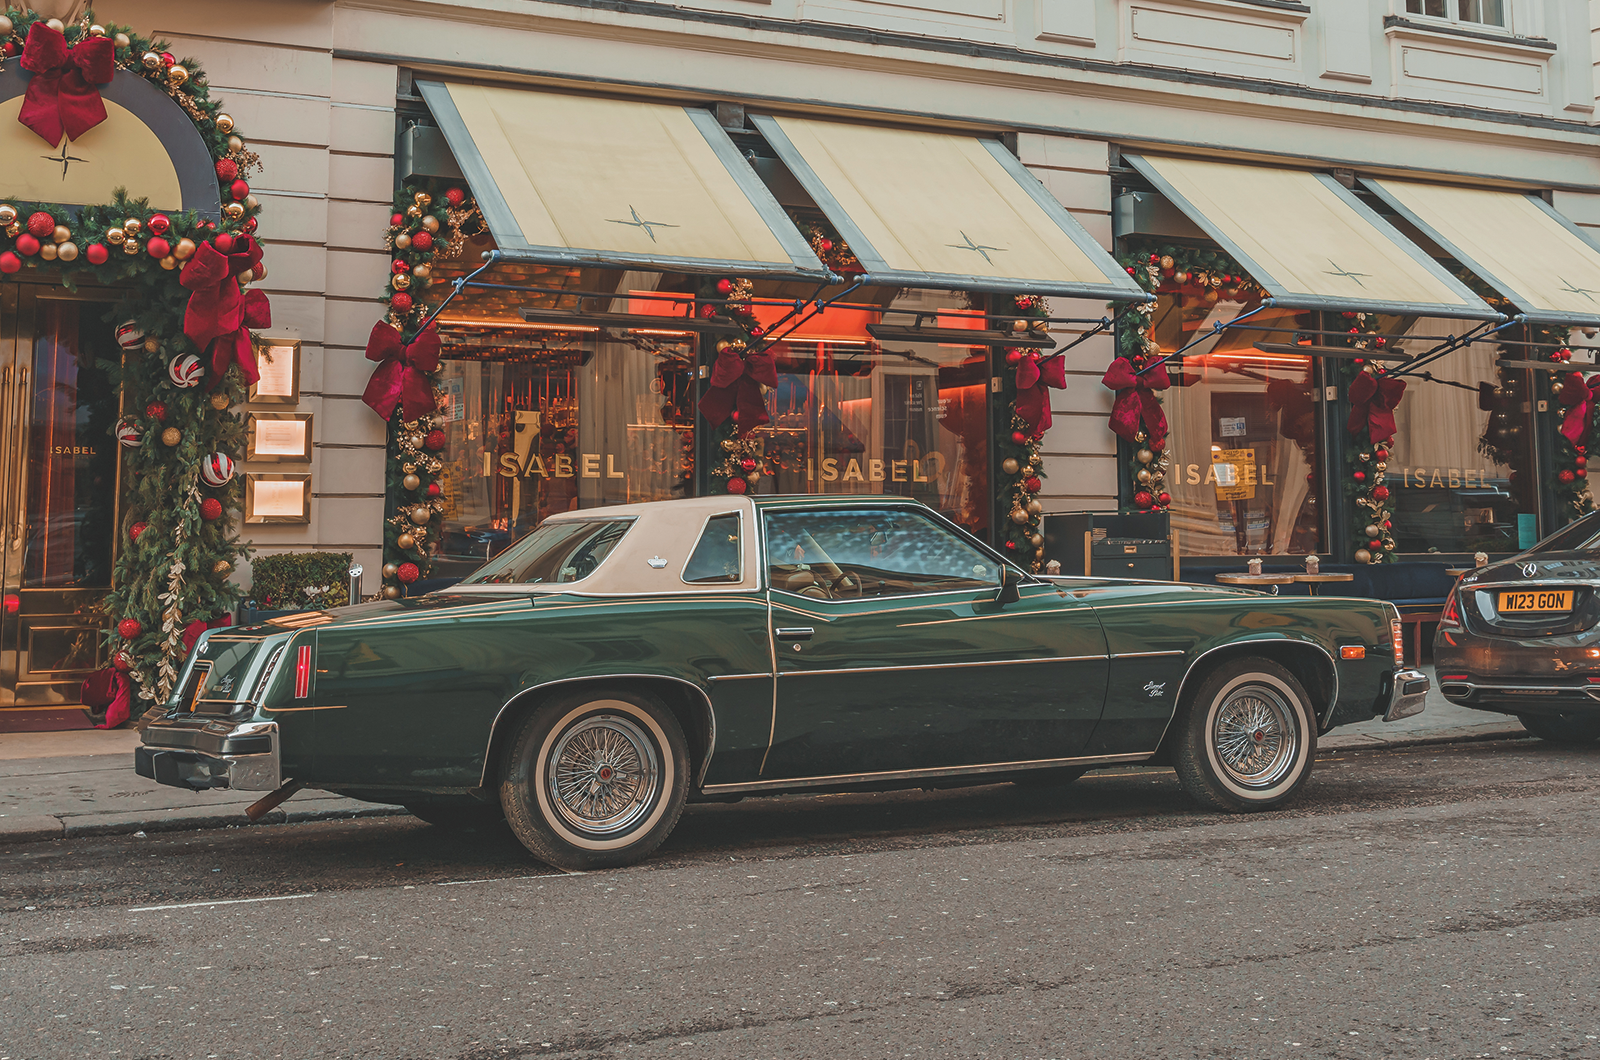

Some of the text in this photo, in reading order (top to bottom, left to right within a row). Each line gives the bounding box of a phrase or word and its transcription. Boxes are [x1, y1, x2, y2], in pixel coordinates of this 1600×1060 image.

[50, 446, 96, 455] ISABEL
[483, 451, 625, 479] ISABEL
[807, 457, 928, 482] ISABEL
[1175, 463, 1274, 485] ISABEL
[1404, 468, 1492, 489] ISABEL
[1538, 592, 1565, 609] GON
